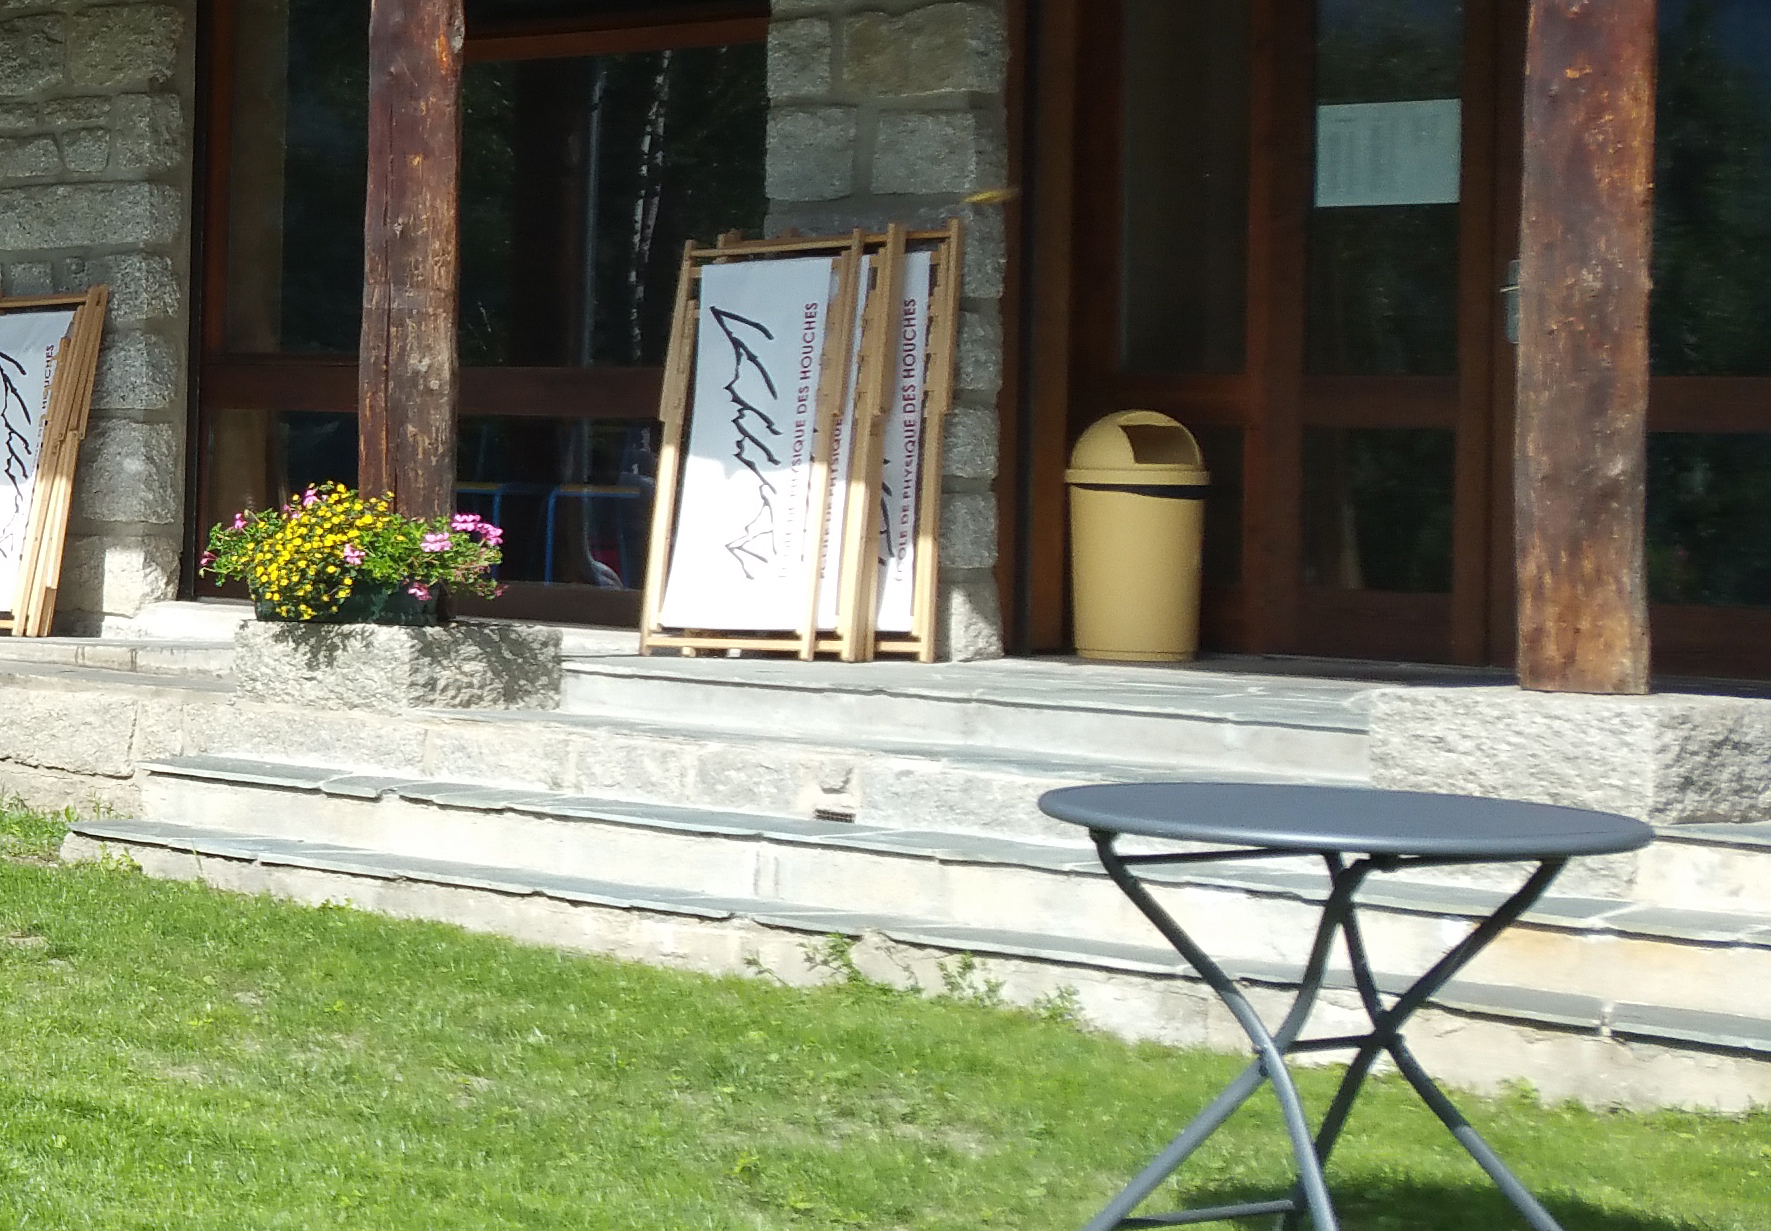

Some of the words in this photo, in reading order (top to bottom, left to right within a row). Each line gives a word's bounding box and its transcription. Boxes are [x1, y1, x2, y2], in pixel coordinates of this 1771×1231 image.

[799, 302, 818, 381] HOUCHES
[902, 298, 917, 380] HOUCHES
[796, 385, 810, 415] DES
[902, 384, 917, 414] DES
[902, 420, 916, 499] PHYSIQUE
